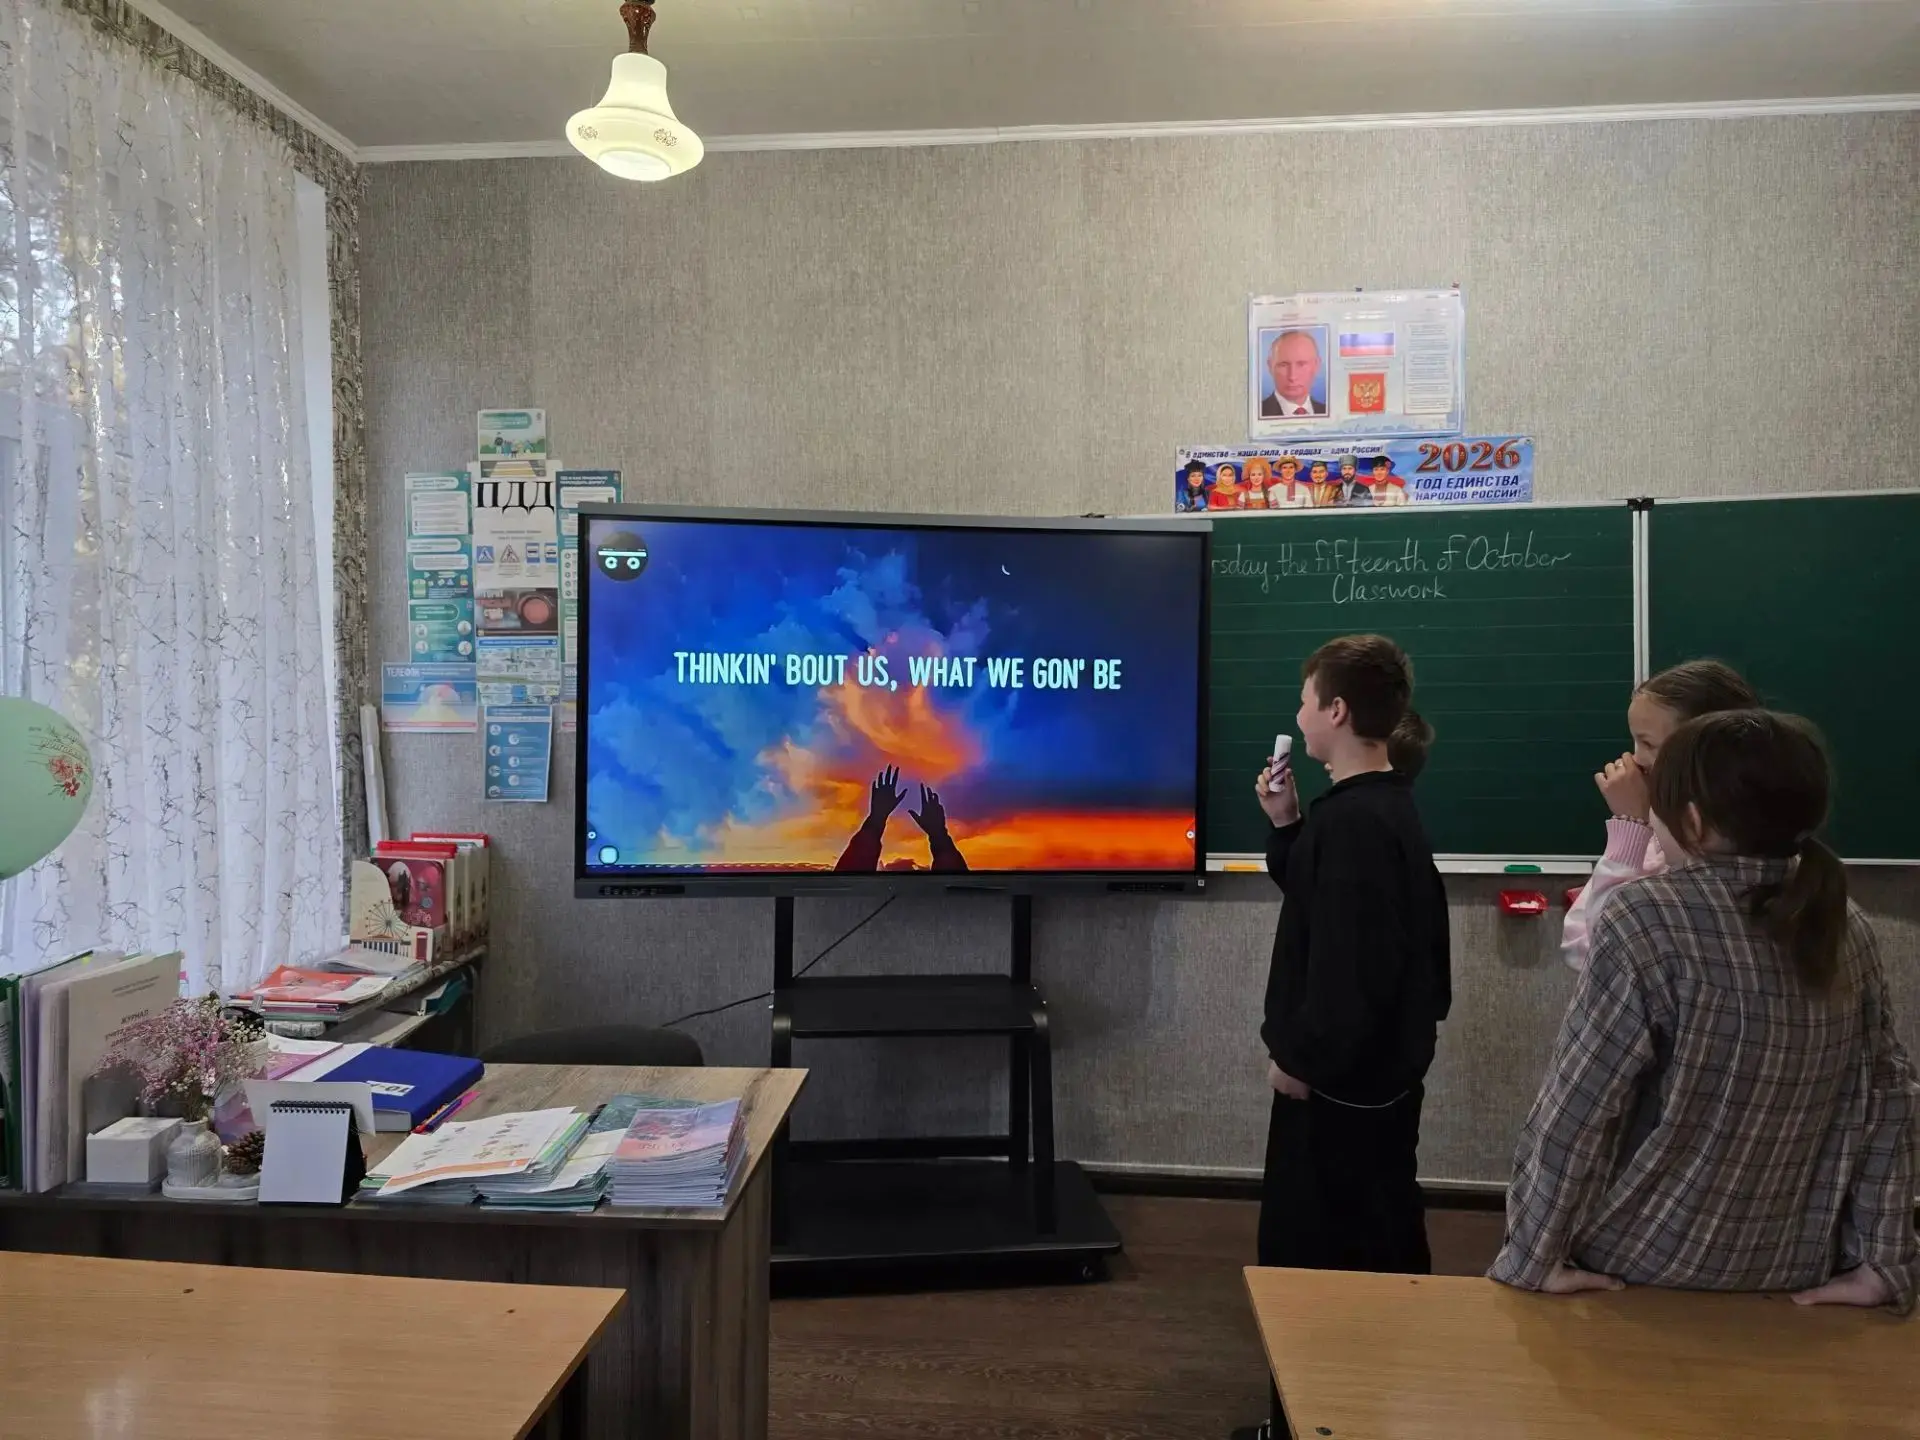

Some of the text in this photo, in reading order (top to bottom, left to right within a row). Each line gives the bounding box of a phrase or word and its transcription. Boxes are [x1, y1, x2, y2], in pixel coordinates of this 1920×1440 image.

[1416, 439, 1521, 473] 2026
[474, 481, 555, 514] ПДД
[1416, 475, 1519, 490] ГОД ЕДИНСТВА
[1416, 490, 1468, 501] НАРОДОВ
[1277, 542, 1308, 576] the
[1437, 534, 1467, 571] of
[1466, 531, 1571, 570] October
[1333, 573, 1448, 604] Classwork
[674, 652, 1122, 691] THINKIN' BOUT US, WHAT WE GON' BE
